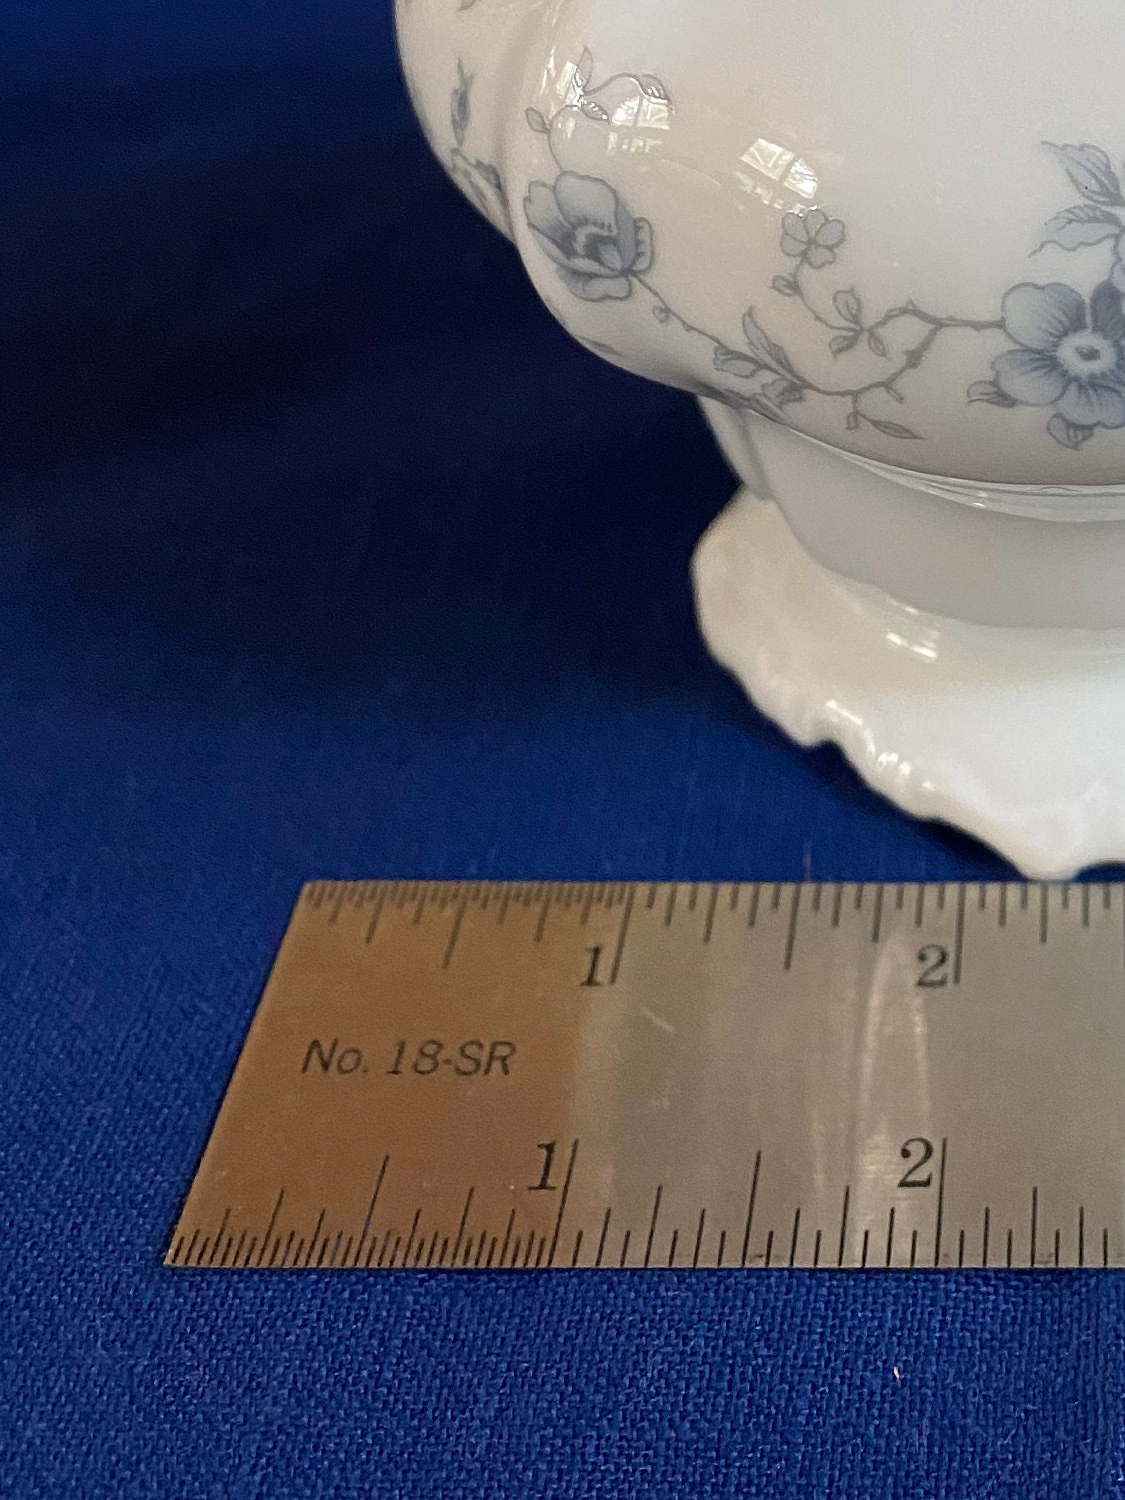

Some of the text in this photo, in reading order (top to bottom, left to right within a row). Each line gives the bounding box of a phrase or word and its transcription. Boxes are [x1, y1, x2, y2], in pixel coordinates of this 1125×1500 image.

[580, 946, 604, 987] 1
[915, 944, 949, 987] 2
[301, 1038, 517, 1076] No. 18-SR
[527, 1141, 558, 1191] 1
[897, 1138, 934, 1188] 2
